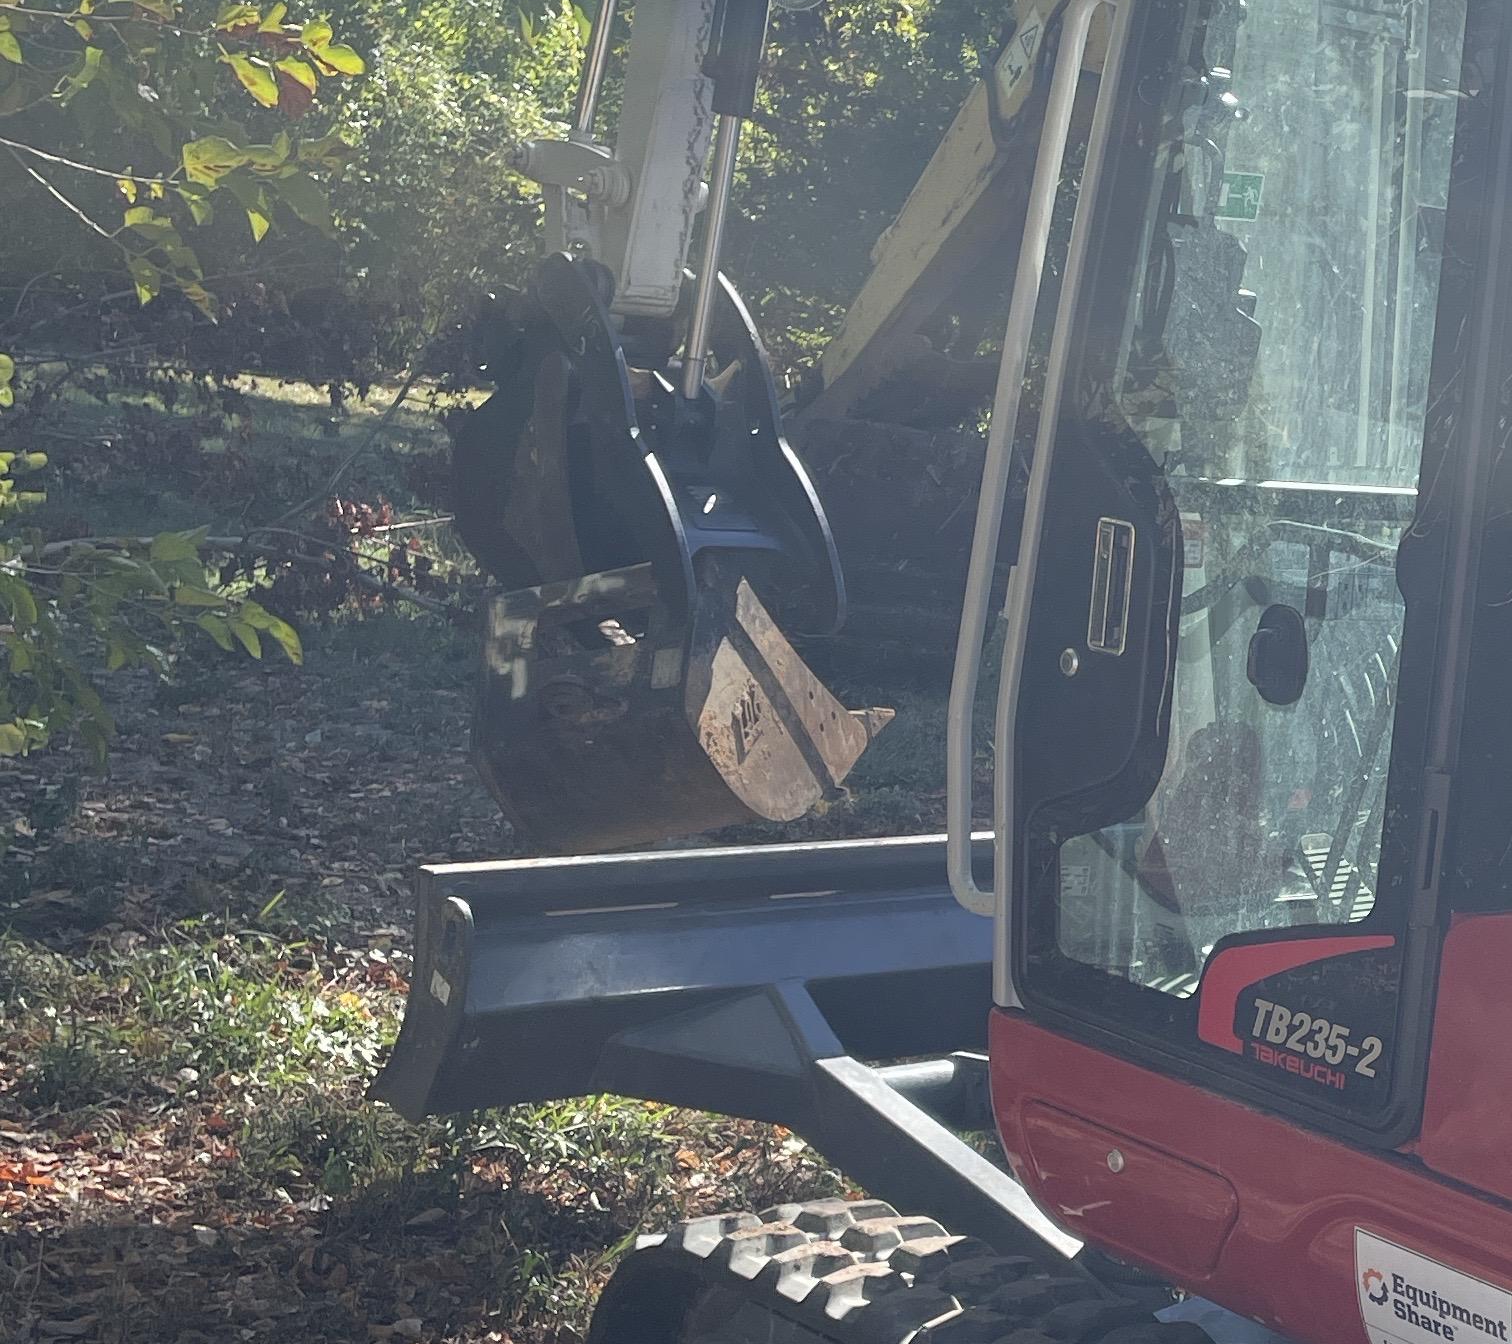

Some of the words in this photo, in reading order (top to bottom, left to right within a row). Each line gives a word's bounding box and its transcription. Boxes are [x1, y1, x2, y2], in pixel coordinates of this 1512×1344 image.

[1252, 998, 1383, 1079] TB235-2
[1391, 1272, 1508, 1343] Equipment
[1393, 1298, 1455, 1342] Share
